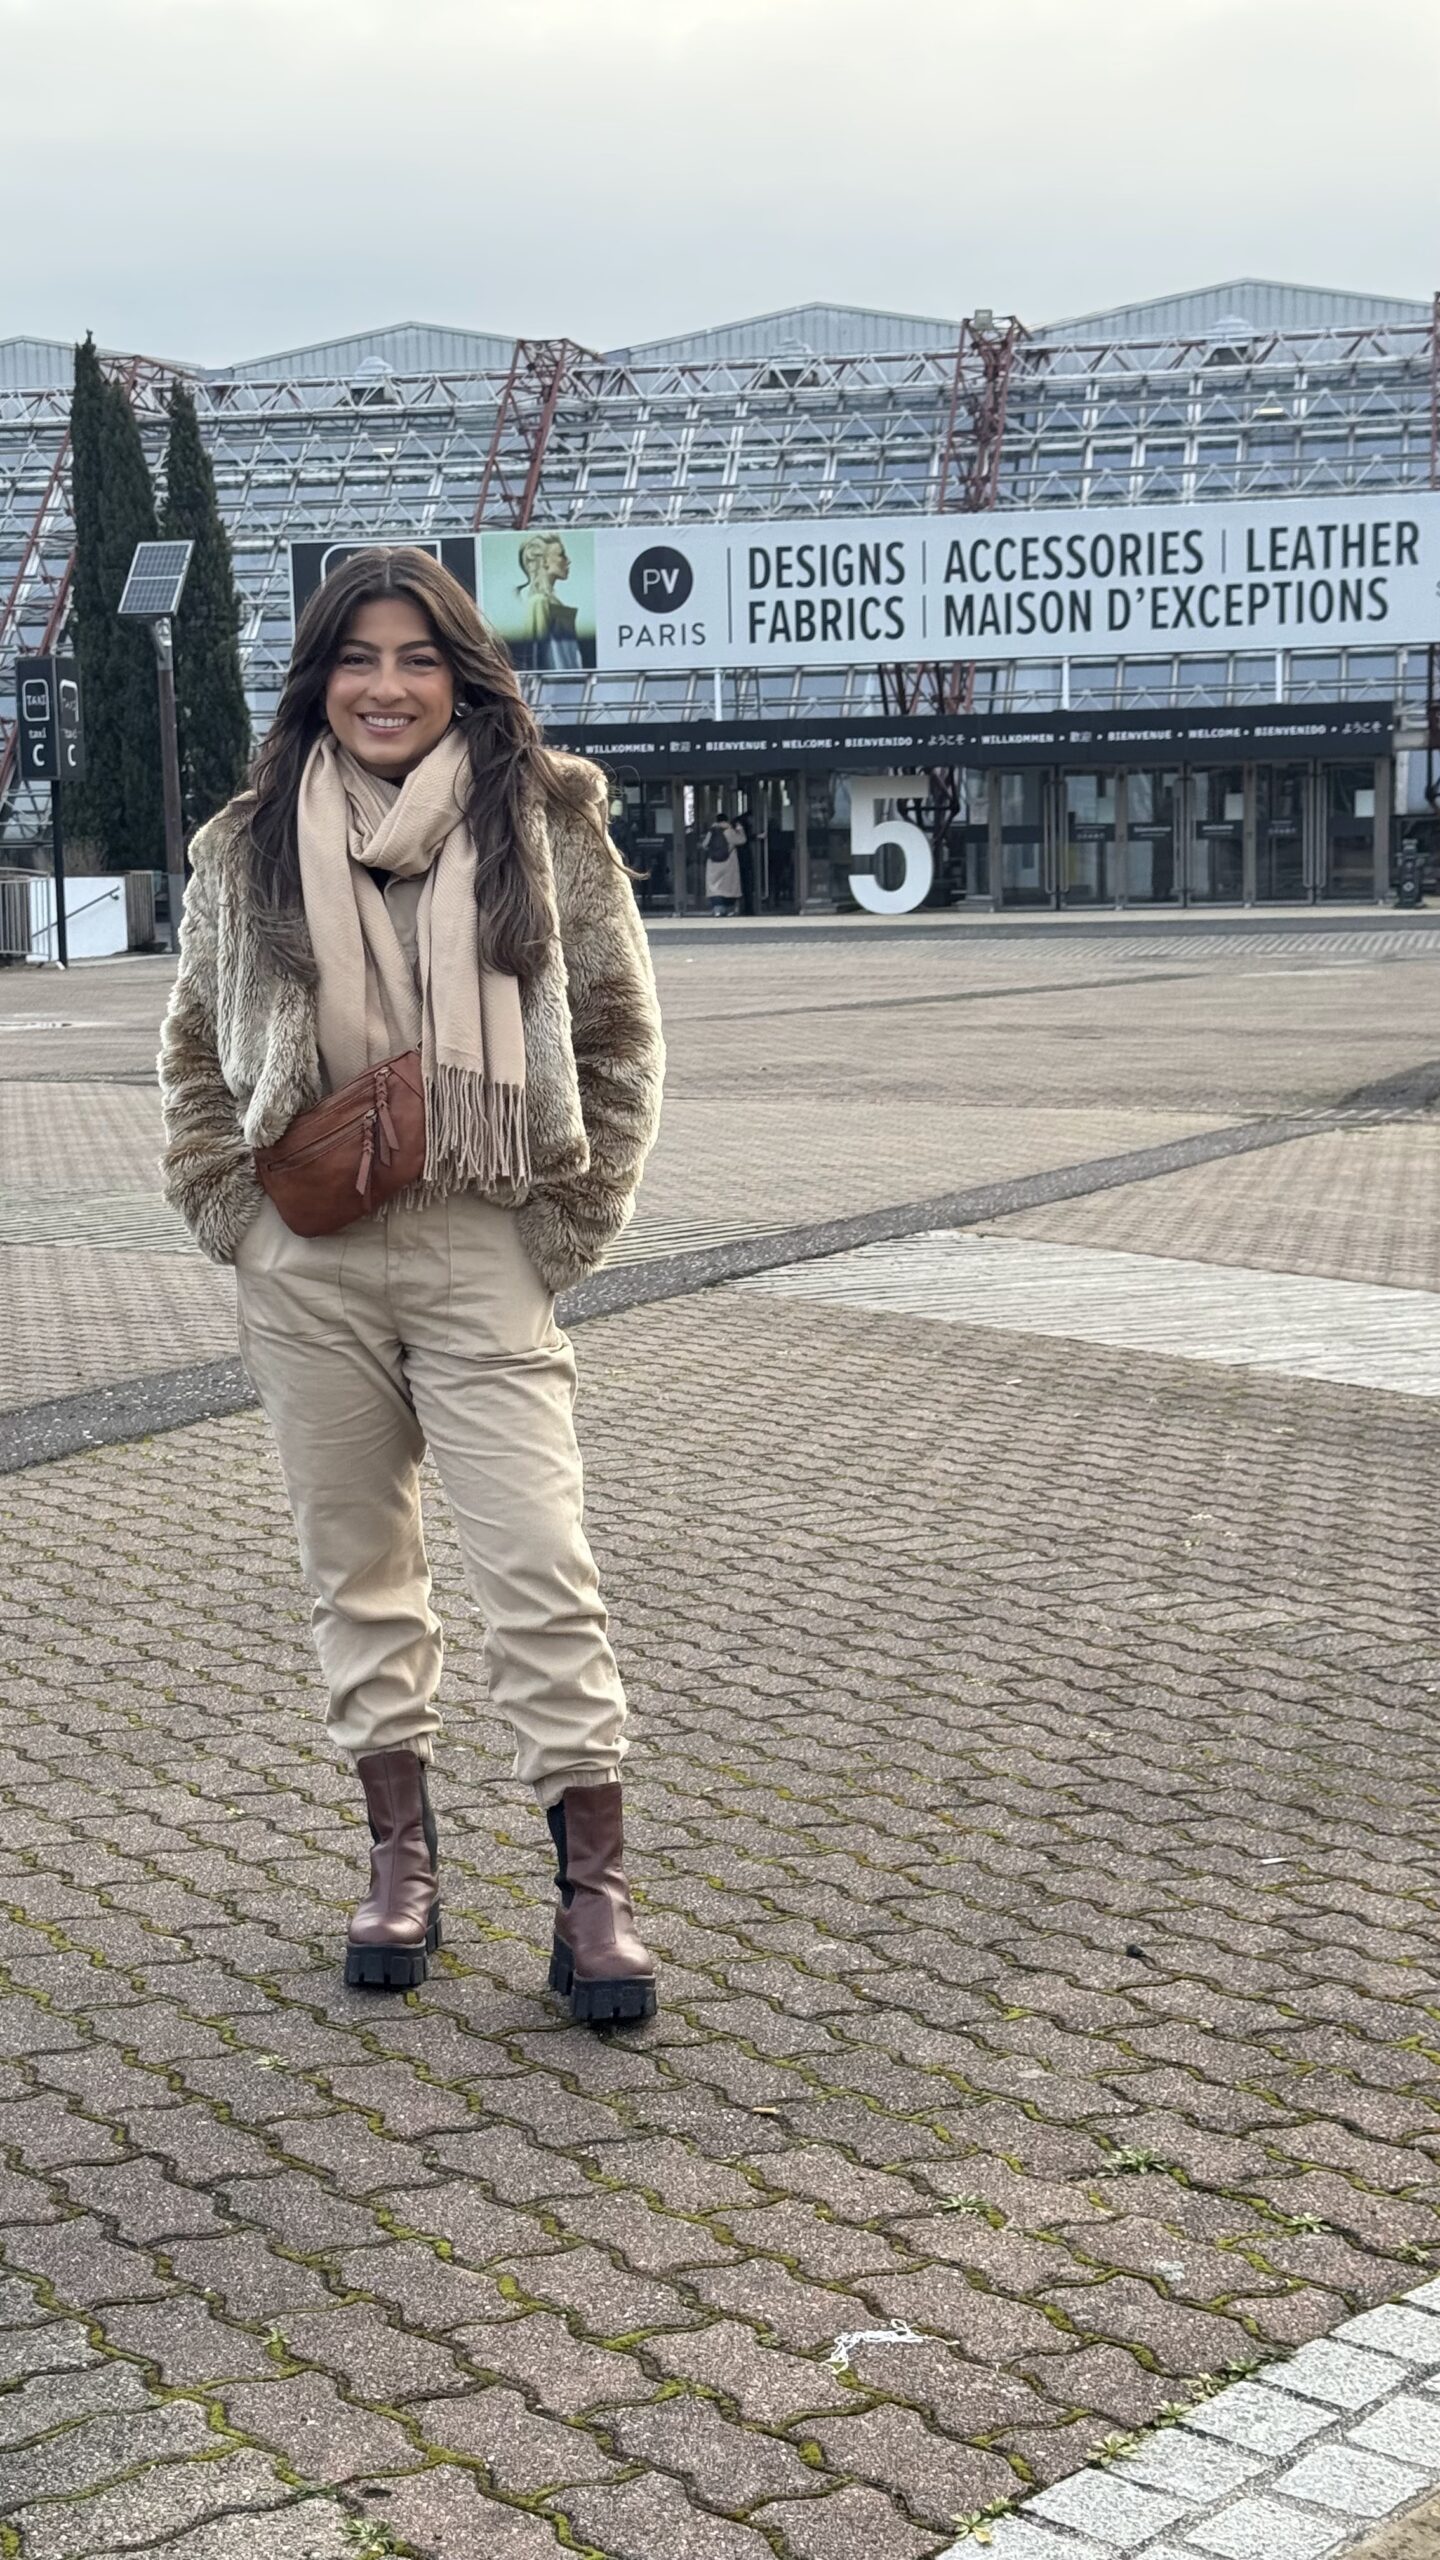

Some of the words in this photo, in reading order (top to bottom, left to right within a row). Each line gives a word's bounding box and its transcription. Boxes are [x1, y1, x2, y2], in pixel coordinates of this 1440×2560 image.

[749, 541, 906, 590] DESIGNS
[943, 529, 1204, 584] ACCESSORIES
[1247, 520, 1419, 573] LEATHER
[642, 567, 680, 595] PV
[748, 595, 906, 645] FABRICS
[944, 589, 1092, 638] MAISON
[1108, 576, 1389, 632] D'EXCEPTIONS
[618, 622, 706, 648] PARIS
[28, 727, 47, 739] taxi
[585, 743, 655, 755] WILLKOMMEN
[705, 740, 768, 752] BIENVENUE
[781, 738, 833, 750] WELCOME
[844, 736, 914, 748] BIENVENIDO
[927, 733, 966, 747] ようこそ
[980, 733, 1055, 745] WILLKOMMEN
[1107, 729, 1173, 742] BIENVENUE
[1187, 727, 1242, 739] WELCOME
[1253, 724, 1328, 737] BIENVENIDO
[1341, 720, 1383, 735] ようこそ
[32, 743, 45, 767] C
[67, 743, 77, 767] C
[849, 775, 934, 915] 5
